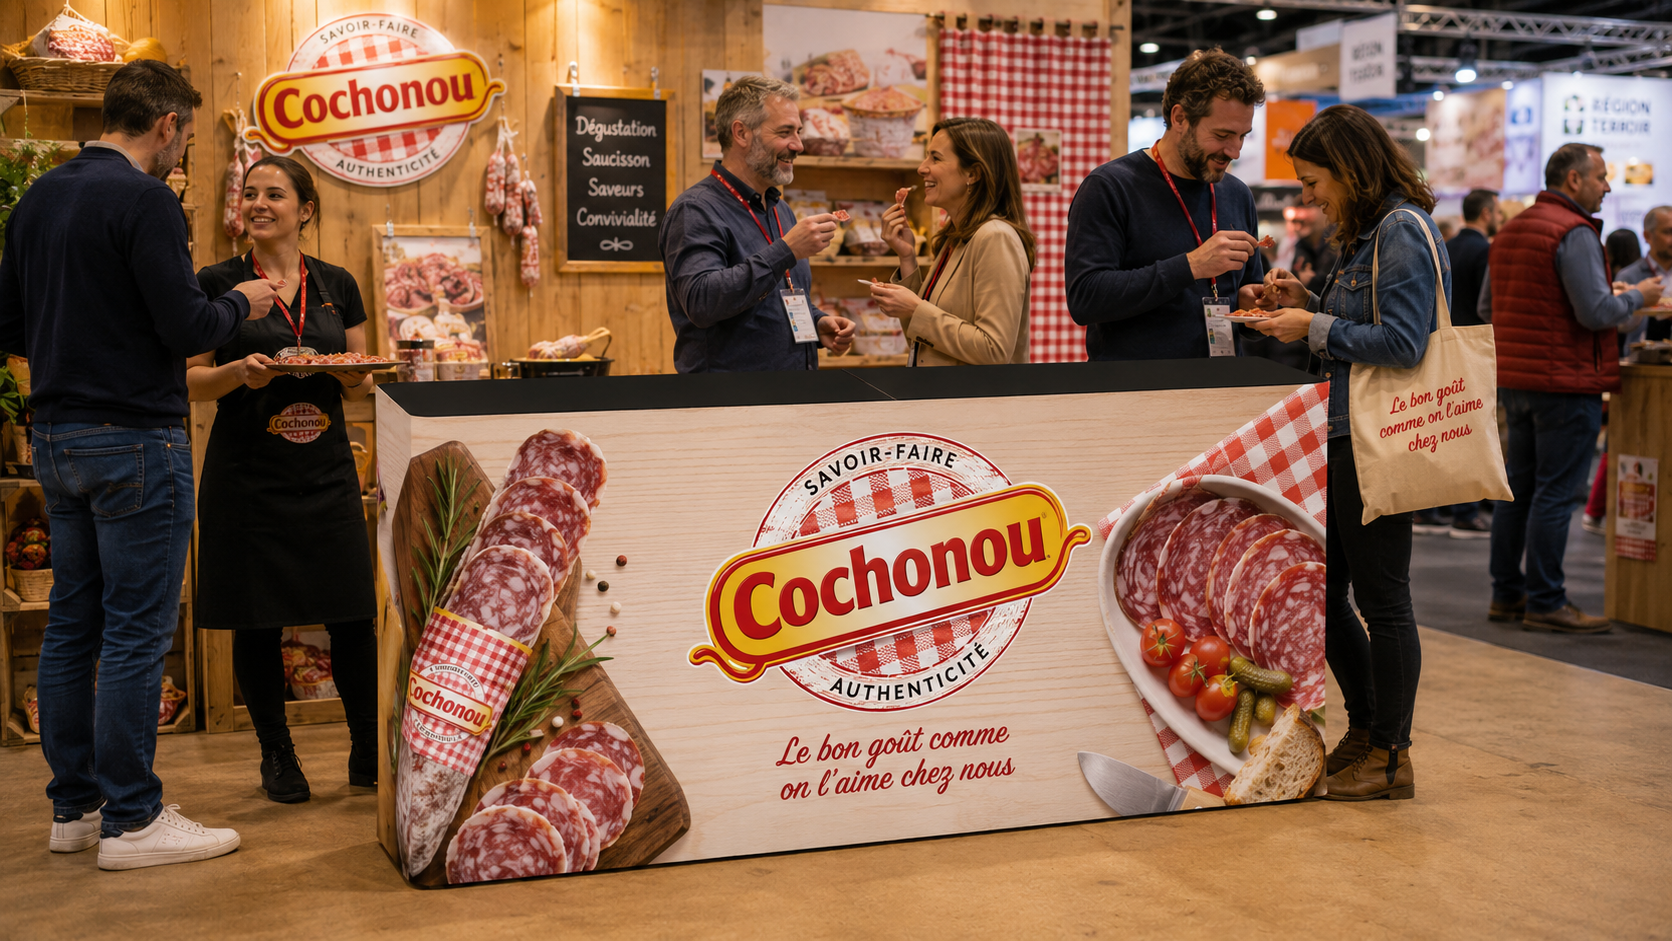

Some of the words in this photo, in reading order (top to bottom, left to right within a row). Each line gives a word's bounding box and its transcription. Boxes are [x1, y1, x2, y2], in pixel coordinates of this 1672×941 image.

[320, 20, 418, 44] SAVOIR-FAIRE
[274, 73, 475, 129] Cochonou
[575, 115, 657, 142] Dégustation
[336, 148, 440, 177] AUTHENTICITÉ
[582, 147, 651, 168] Saucisson
[588, 177, 644, 197] Saveurs
[576, 207, 657, 227] Convivialité
[1390, 396, 1407, 414] Le
[1410, 392, 1433, 407] bon
[1436, 377, 1466, 406] goût
[274, 417, 326, 430] Cochonou
[1379, 416, 1425, 438] comme
[1428, 410, 1444, 424] on
[1446, 398, 1483, 418] l'aime
[1408, 433, 1438, 453] chez
[1441, 424, 1472, 442] nous
[804, 444, 958, 496] SAVOIR-FAIRE
[733, 516, 1047, 640] Cochonou
[830, 642, 990, 701] AUTHENTICITÉ
[776, 737, 811, 766] Le
[817, 733, 861, 761] bon
[868, 727, 924, 768] goût
[929, 726, 1010, 750] comme
[780, 779, 811, 800] on
[818, 768, 893, 797] l'aime
[901, 758, 954, 794] chez
[960, 757, 1015, 780] nous
